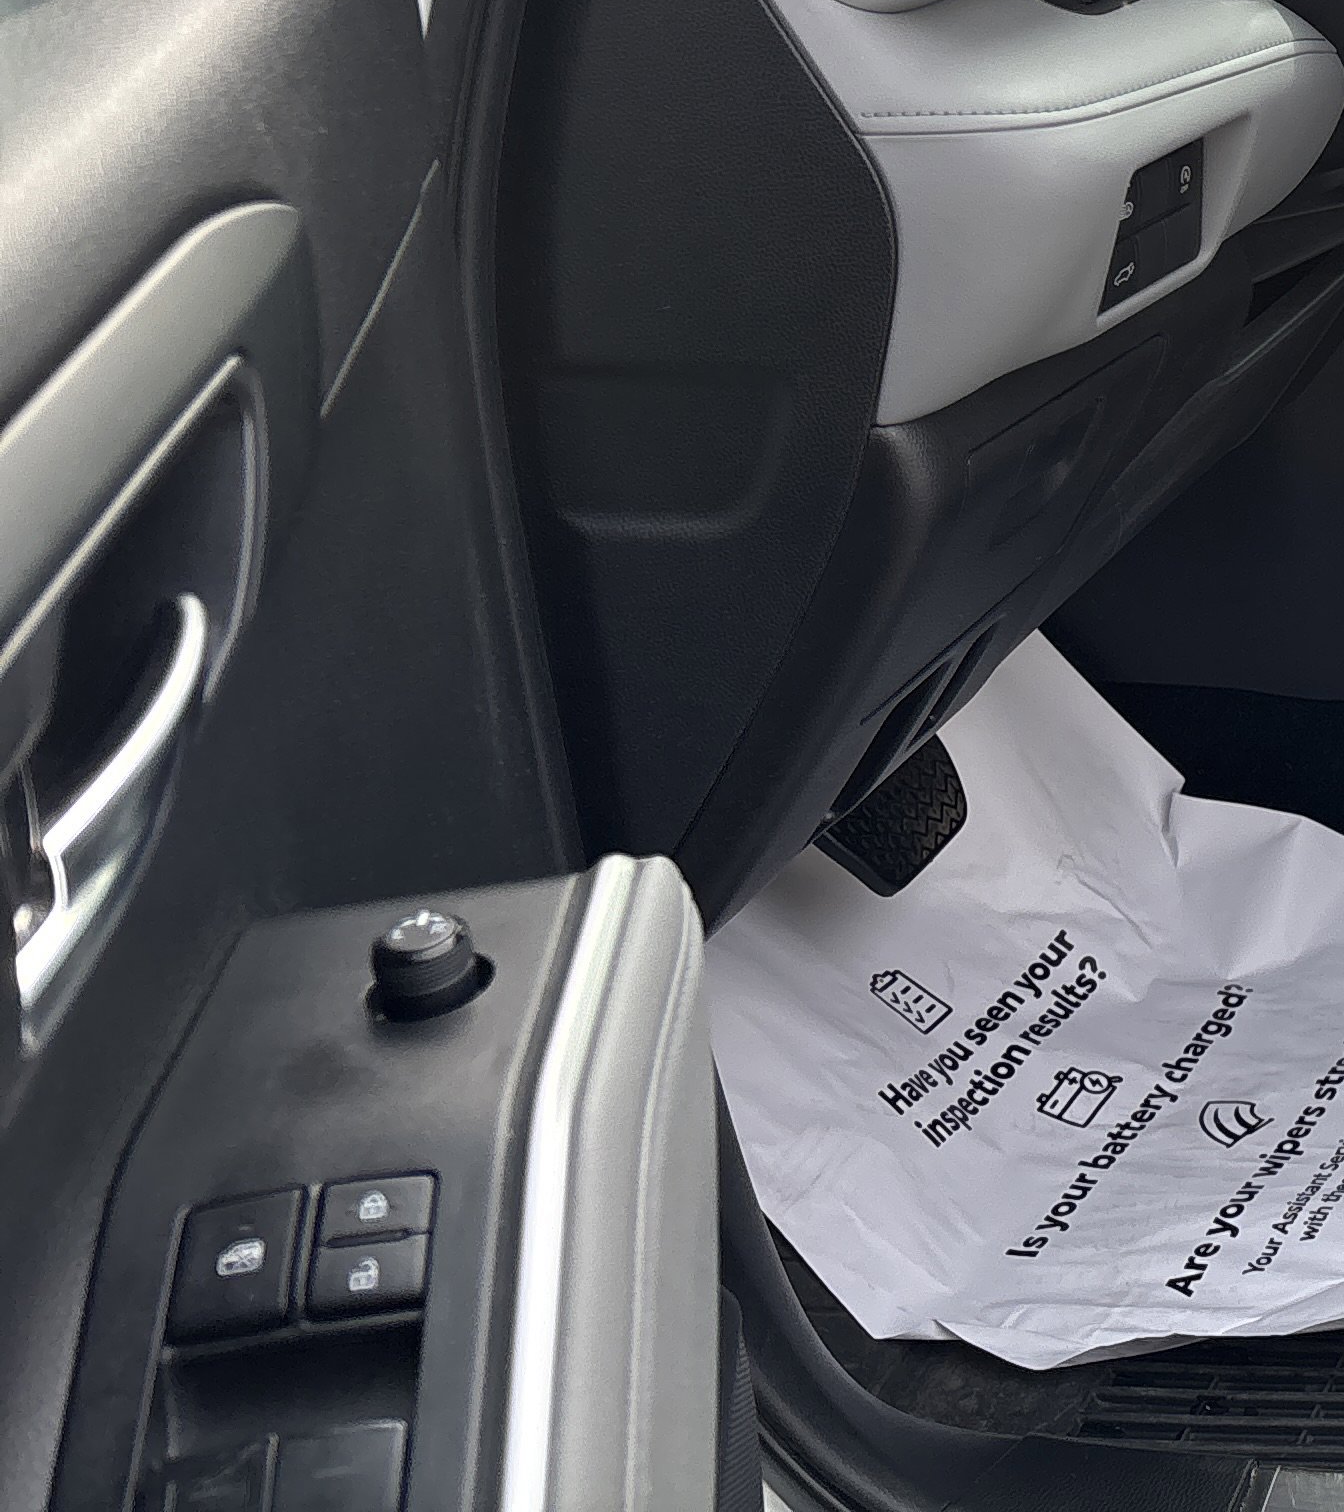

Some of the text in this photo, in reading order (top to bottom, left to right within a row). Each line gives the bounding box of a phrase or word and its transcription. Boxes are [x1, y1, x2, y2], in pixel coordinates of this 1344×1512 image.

[878, 930, 1074, 1115] Have you seen your
[914, 956, 1106, 1147] inspection results?
[1005, 984, 1253, 1257] Is your battery charged?
[1165, 1242, 1221, 1297] Are
[1206, 1181, 1264, 1238] your
[1253, 1106, 1326, 1178] wipers
[1242, 1238, 1282, 1275] Your
[1272, 1173, 1332, 1234] Assistant
[1300, 1204, 1333, 1242] with
